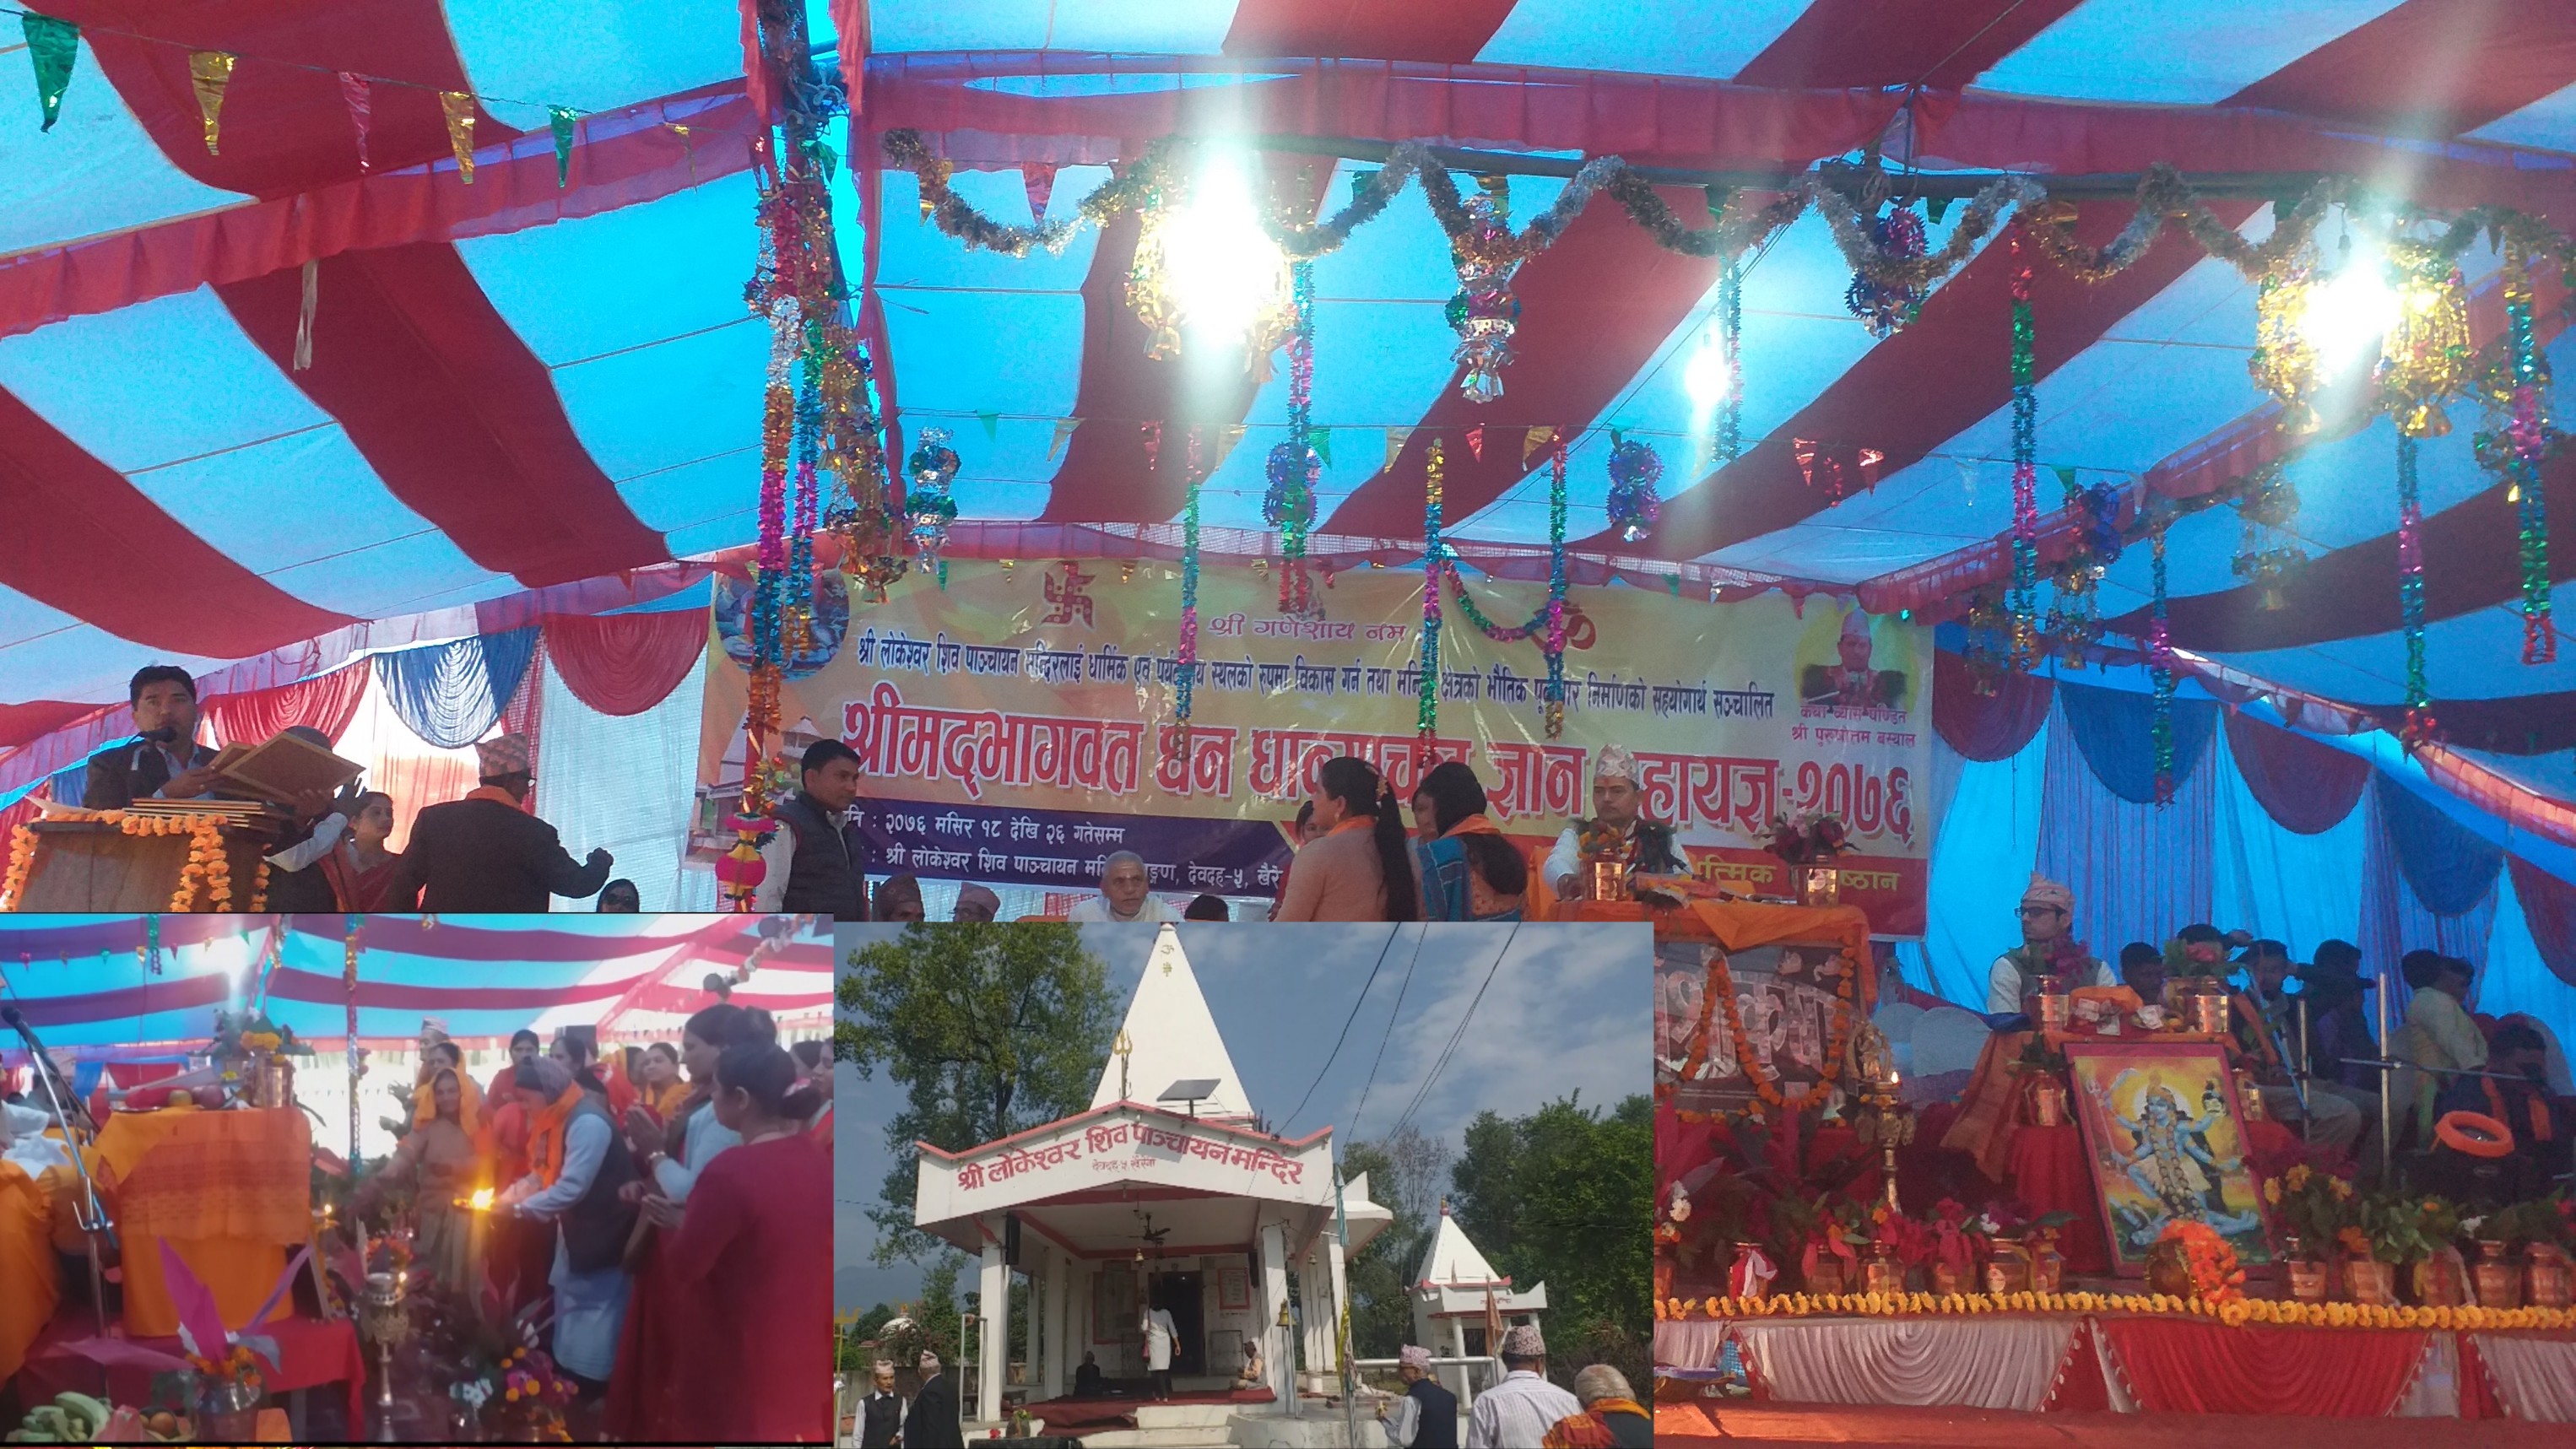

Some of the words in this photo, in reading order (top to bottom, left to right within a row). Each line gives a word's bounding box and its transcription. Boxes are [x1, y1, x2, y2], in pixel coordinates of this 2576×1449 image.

[1209, 614, 1245, 635] श्री
[1253, 618, 1355, 641] गणेशाय
[858, 629, 875, 664] श्री
[881, 633, 931, 673] लोकेश्वर
[937, 633, 961, 673] शिव
[966, 646, 1020, 675] पाञ्चायन
[1089, 645, 1128, 682] धार्मिक
[1212, 656, 1253, 690] स्थलको
[1296, 655, 1336, 695] विकास
[1342, 659, 1361, 692] गर्न
[1367, 668, 1392, 695] तथा
[1441, 666, 1481, 701] क्षेत्रको
[1486, 662, 1529, 702] भौतिक
[1587, 672, 1648, 711] निर्माणको
[1653, 680, 1707, 719] सहयोगार्थ
[1713, 681, 1775, 720] सञ्चालित
[1791, 723, 1809, 740] श्री
[844, 682, 1145, 797] श्रीमद्भागवत
[1156, 723, 1237, 797] धन
[1486, 741, 1588, 822] ज्ञान
[886, 814, 927, 835] २०७६
[981, 819, 1003, 838] १८
[1010, 816, 1040, 841] देखि
[1046, 824, 1065, 845] २६
[1074, 821, 1126, 844] गतेसम्म
[886, 842, 906, 865] श्री
[912, 846, 971, 873] लोकेश्वर
[978, 846, 1008, 873] शिव
[1014, 856, 1079, 875] पाञ्चायन
[958, 1162, 985, 1191] श्री
[988, 1139, 1081, 1184] लोकेश्वर
[1085, 1124, 1128, 1154] शिव
[1231, 1146, 1305, 1185] मन्दिर
